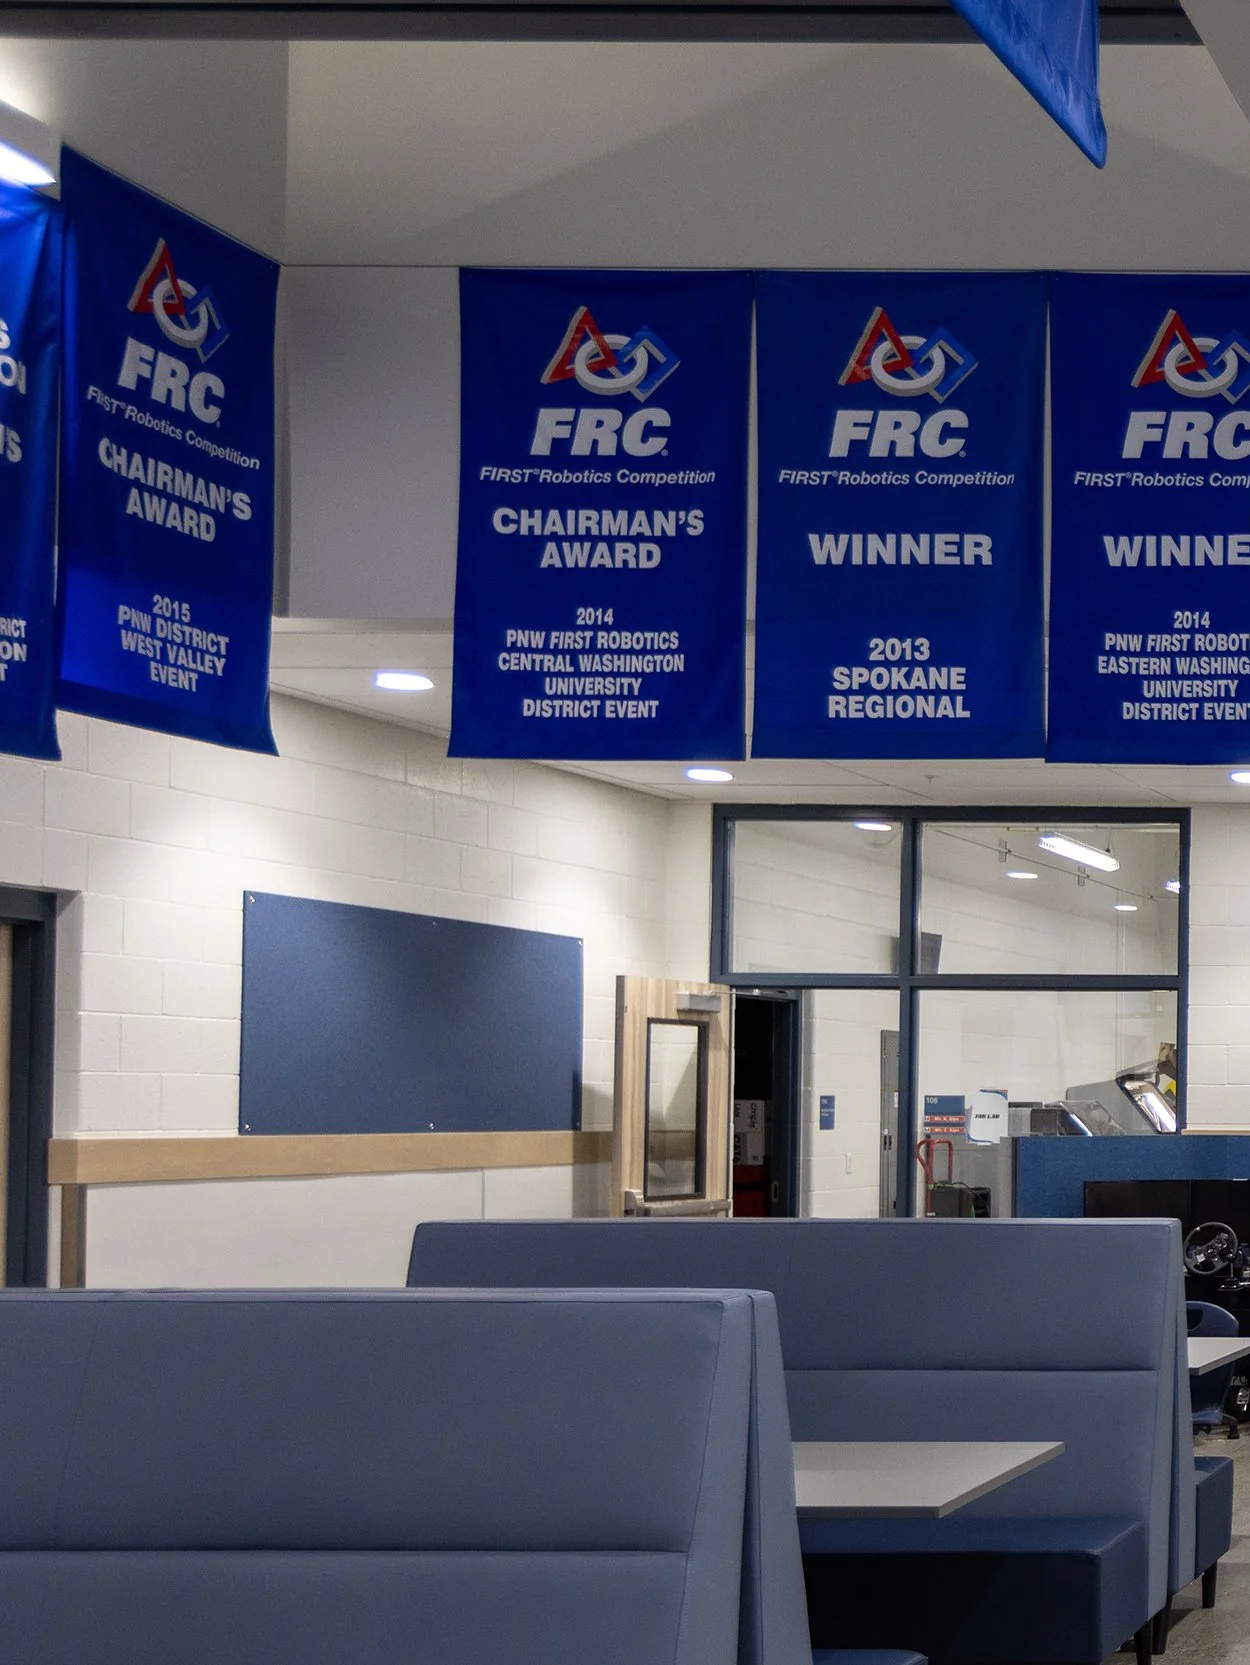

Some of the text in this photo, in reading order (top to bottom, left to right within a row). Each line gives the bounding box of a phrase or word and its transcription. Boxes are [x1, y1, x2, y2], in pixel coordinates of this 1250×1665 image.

[124, 405, 184, 441] Robotics
[185, 429, 261, 470] Competition
[98, 436, 253, 521] CHAIRMAN'S
[539, 468, 612, 484] Robotics
[616, 468, 716, 487] Competition
[837, 471, 911, 486] Robotics
[914, 470, 1015, 488] Competition
[1131, 472, 1205, 488] Robotics
[125, 487, 217, 543] AWARD
[492, 507, 705, 537] CHAIRMAN'S
[539, 541, 662, 569] AWARD
[808, 533, 993, 565] WINNER
[152, 594, 192, 623] 2015
[576, 607, 614, 626] 2014
[1173, 610, 1211, 629] 2014
[117, 604, 230, 656] PNW DISTRICT
[506, 629, 679, 650] PNW FIRST ROBOTICS
[121, 629, 227, 677] WEST VALLEY
[868, 637, 931, 661] 2013
[1104, 632, 1143, 653] PNW
[1147, 633, 1191, 653] FIRST
[498, 652, 685, 673] CENTRAL WASHINGTON
[1097, 656, 1172, 675] EASTERN
[149, 661, 199, 693] EVENT
[545, 677, 642, 696] UNIVERSITY
[832, 666, 967, 691] SPOKANE
[1142, 679, 1239, 698] UNIVERSITY
[523, 698, 659, 719] DISTRICT EVENT
[828, 694, 971, 719] REGIONAL
[1122, 701, 1200, 721] DISTRICT
